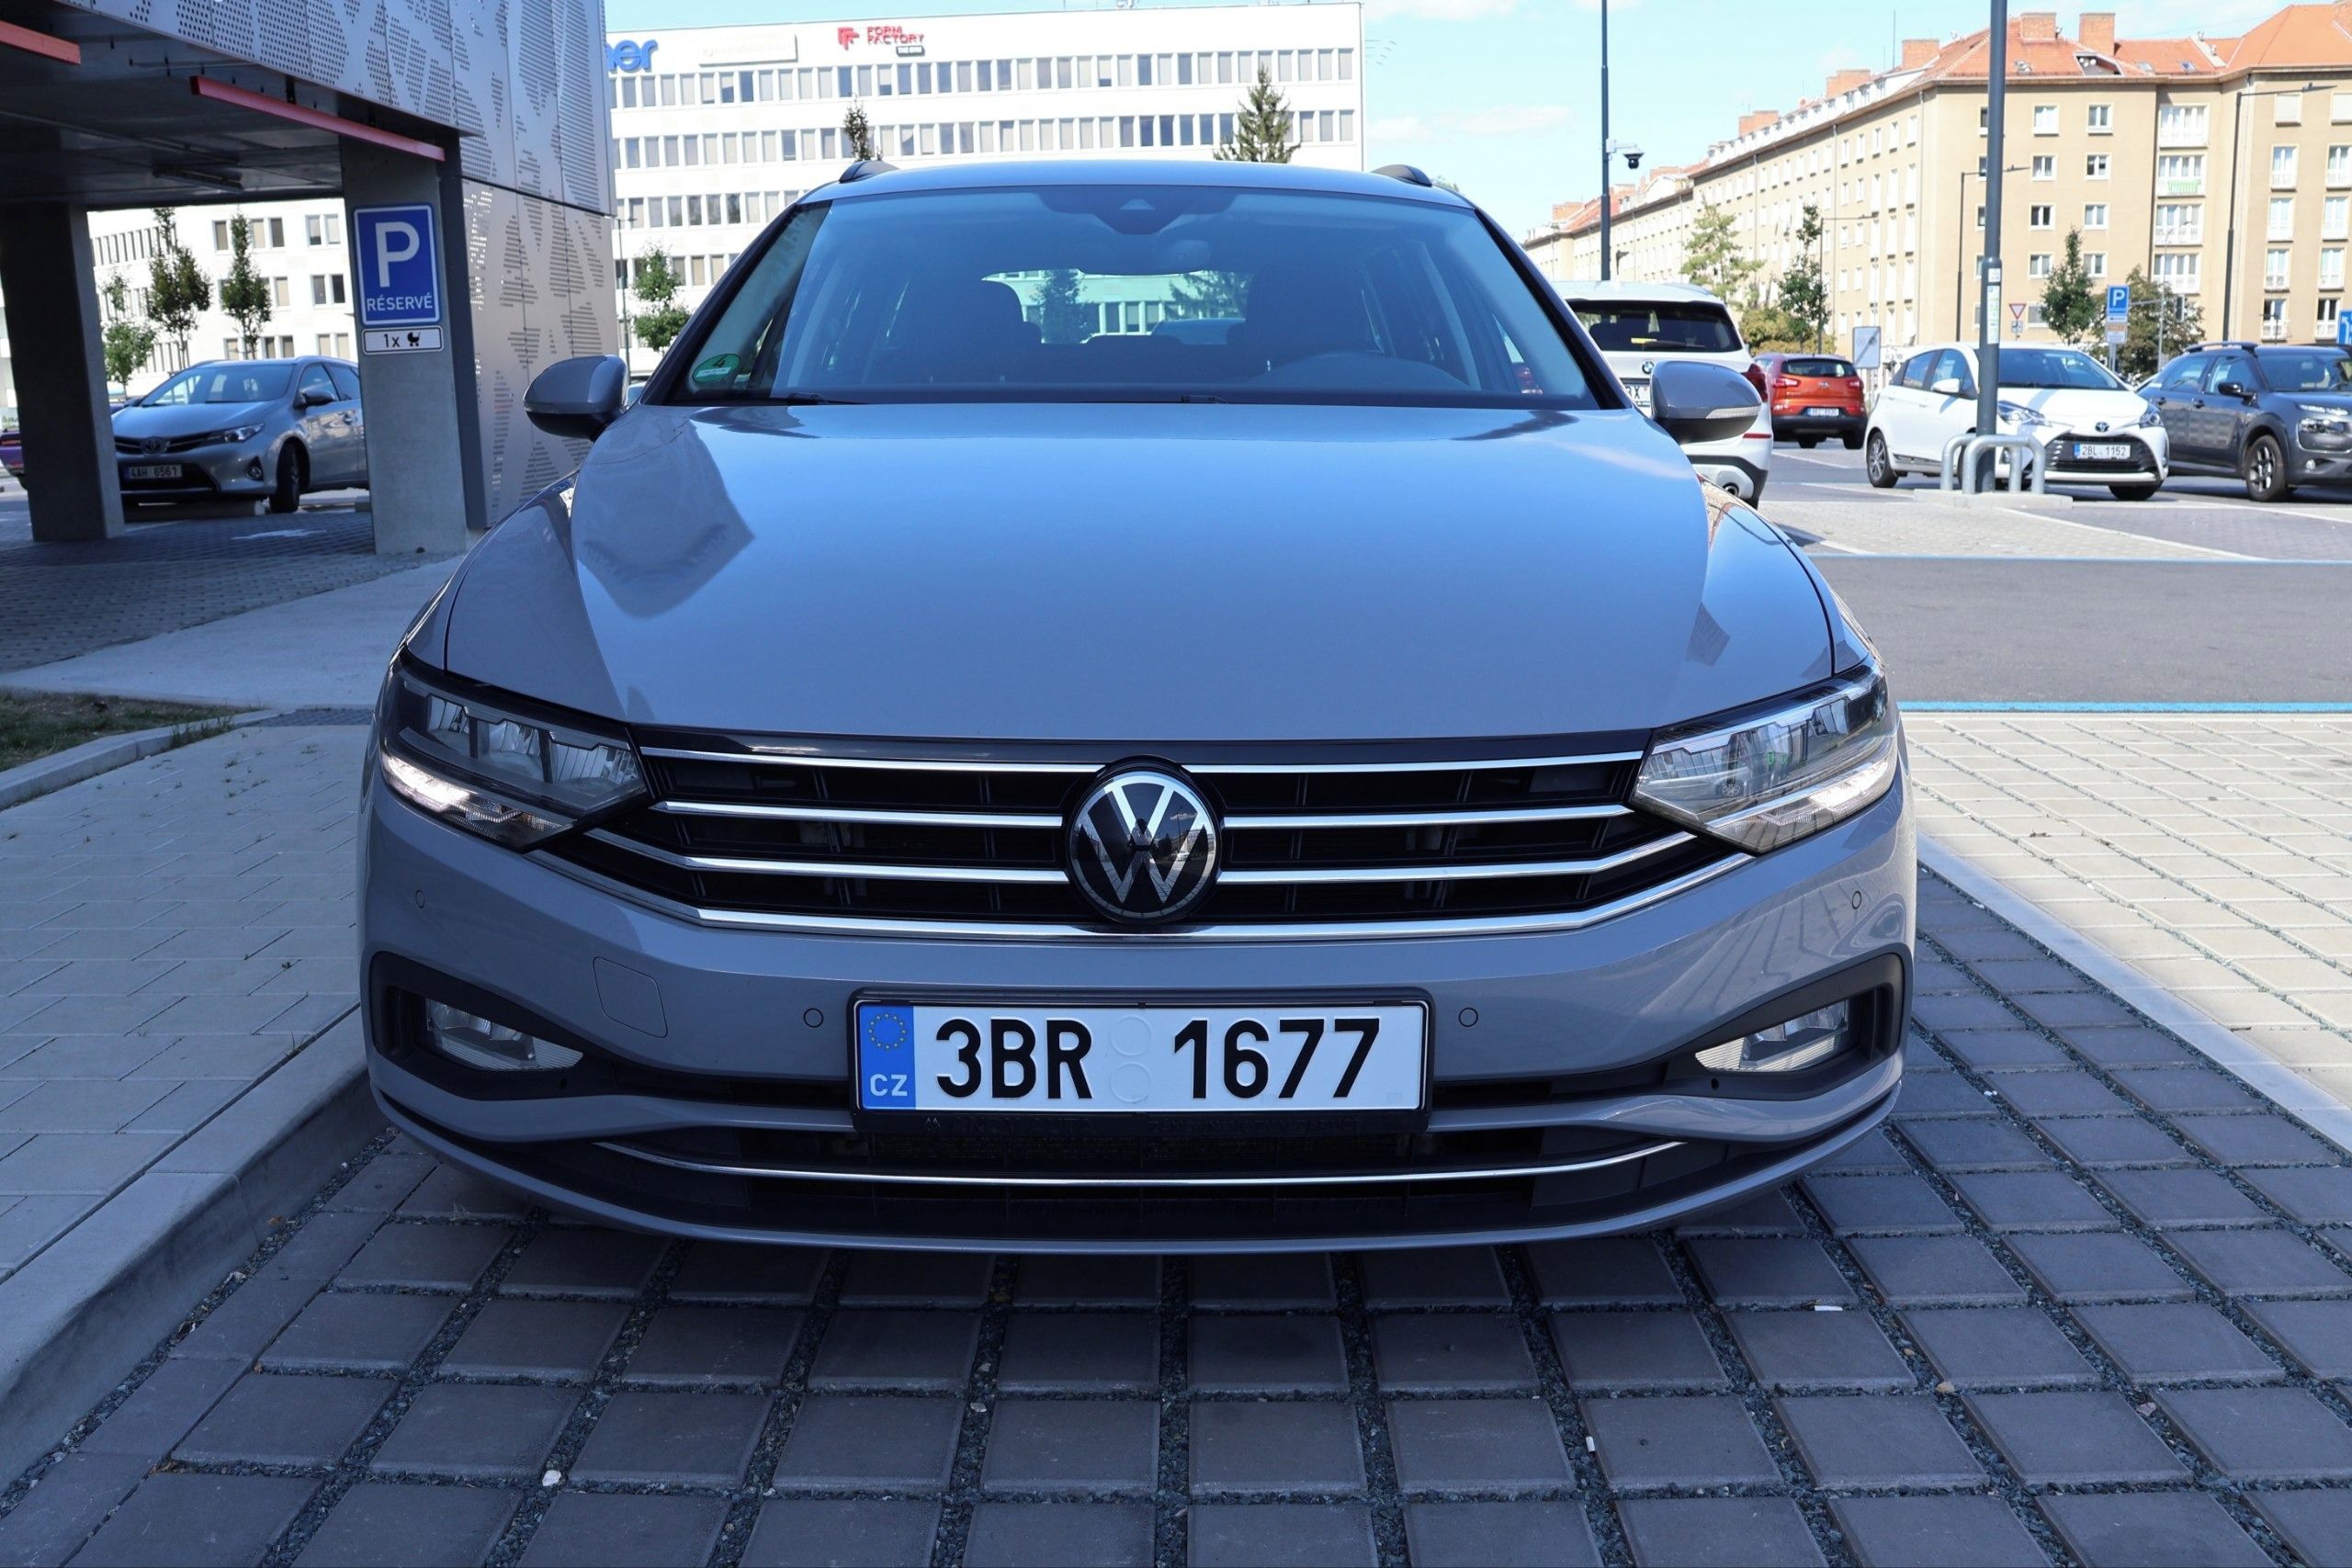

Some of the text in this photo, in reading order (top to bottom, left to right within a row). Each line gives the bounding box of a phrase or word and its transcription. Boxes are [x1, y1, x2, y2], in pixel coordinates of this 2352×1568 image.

[867, 33, 924, 45] FACTORY
[375, 221, 420, 288] P
[367, 293, 433, 311] RÉSERVÉ
[2112, 289, 2126, 307] P
[383, 333, 401, 348] 1x
[936, 1018, 1379, 1099] 3BR 1677
[870, 1074, 908, 1097] CZ
